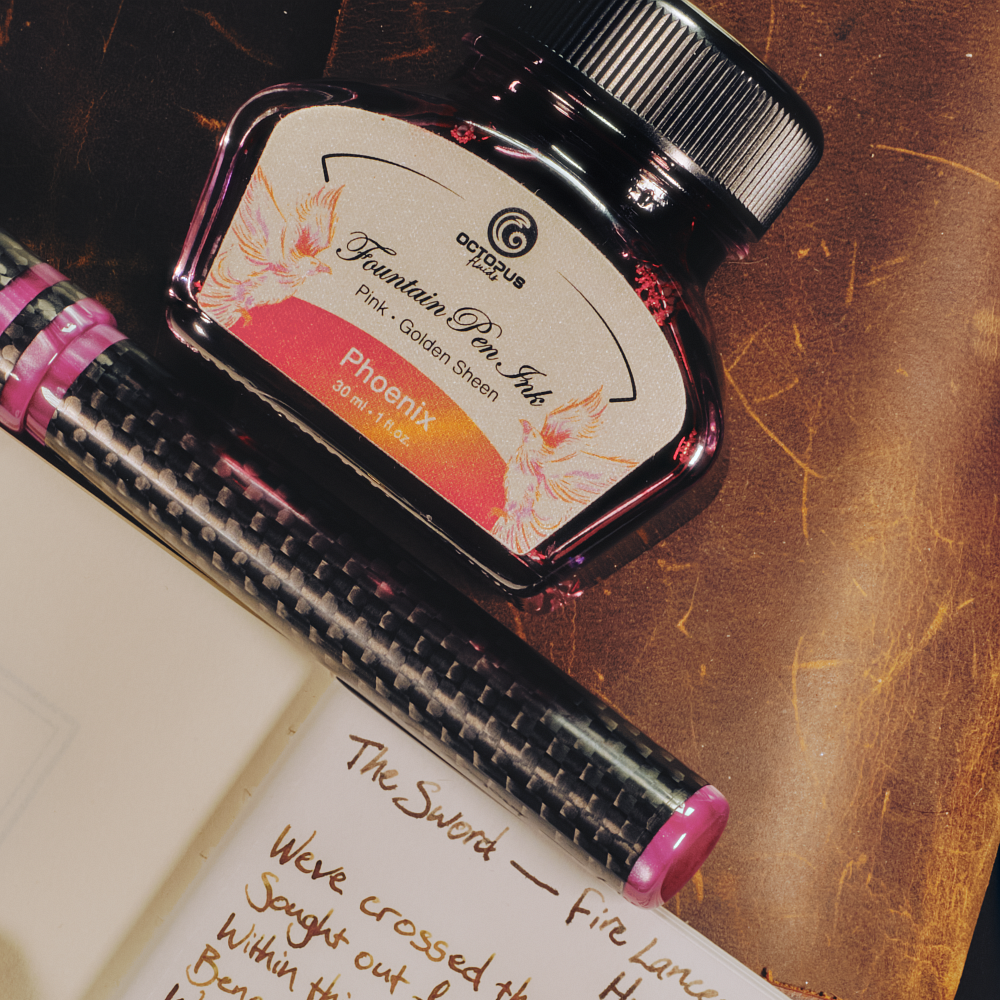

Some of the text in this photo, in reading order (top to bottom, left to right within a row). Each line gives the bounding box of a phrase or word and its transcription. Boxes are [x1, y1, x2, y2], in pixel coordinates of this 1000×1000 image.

[456, 232, 526, 289] OCTOPUS
[466, 256, 499, 281] fluids
[336, 231, 553, 407] Fountain Pen Ink
[354, 284, 500, 403] Pink Golden Sheen
[332, 379, 351, 398] 30
[349, 395, 369, 412] ml
[375, 412, 384, 423] 1
[339, 347, 436, 432] Phoenix
[346, 734, 399, 791] The
[391, 780, 510, 862] Sword
[564, 887, 627, 947] Fire
[216, 912, 298, 993] Within
[244, 871, 350, 950] Sought
[353, 950, 411, 996] out
[359, 895, 496, 993] crossed
